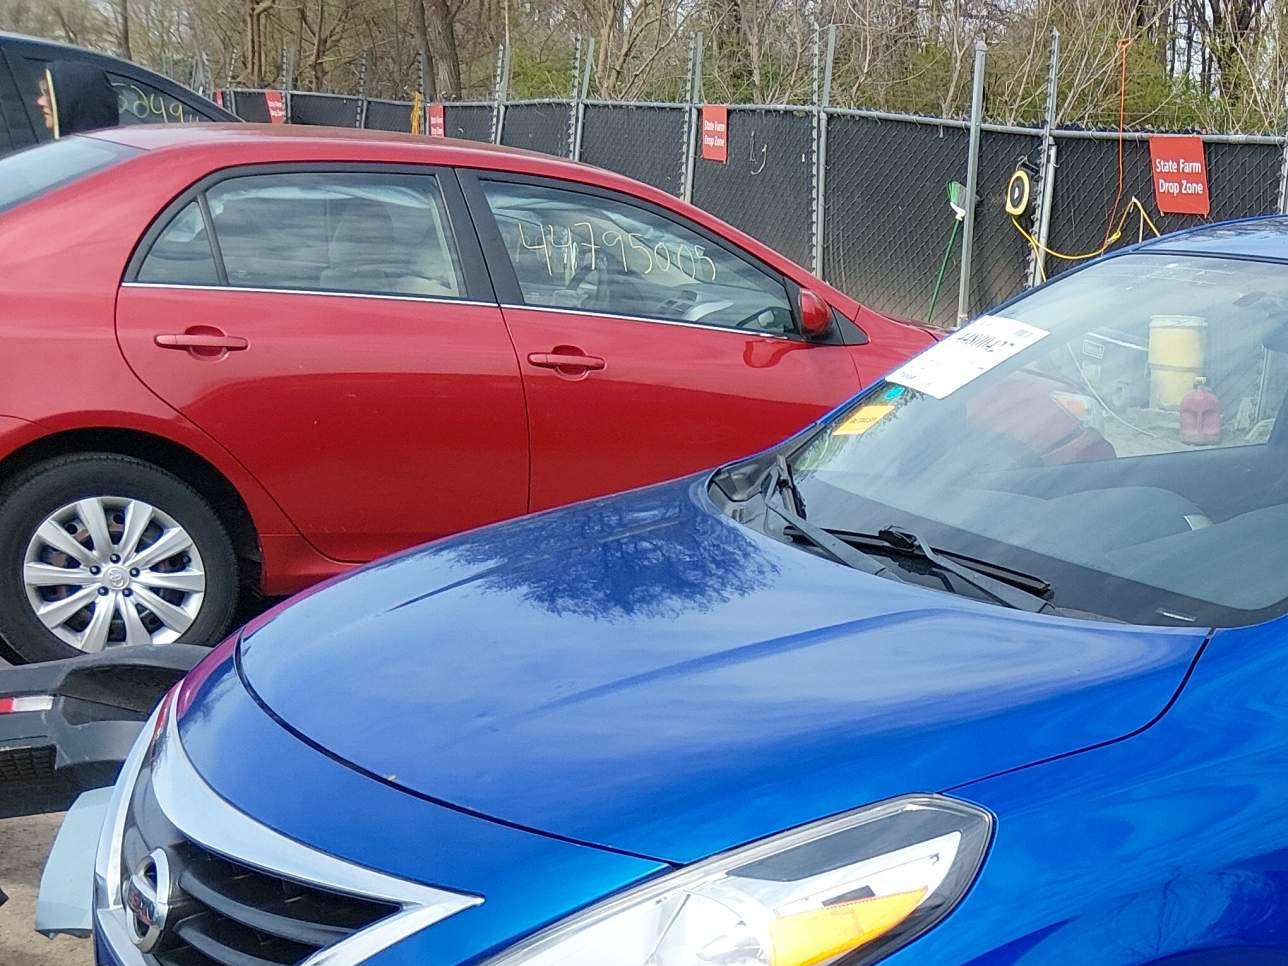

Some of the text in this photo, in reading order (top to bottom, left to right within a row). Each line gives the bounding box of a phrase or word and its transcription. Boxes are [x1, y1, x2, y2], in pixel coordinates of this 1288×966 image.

[1155, 158, 1202, 174] State Farm
[1159, 178, 1204, 197] Drop Zone
[518, 222, 716, 282] 44795005
